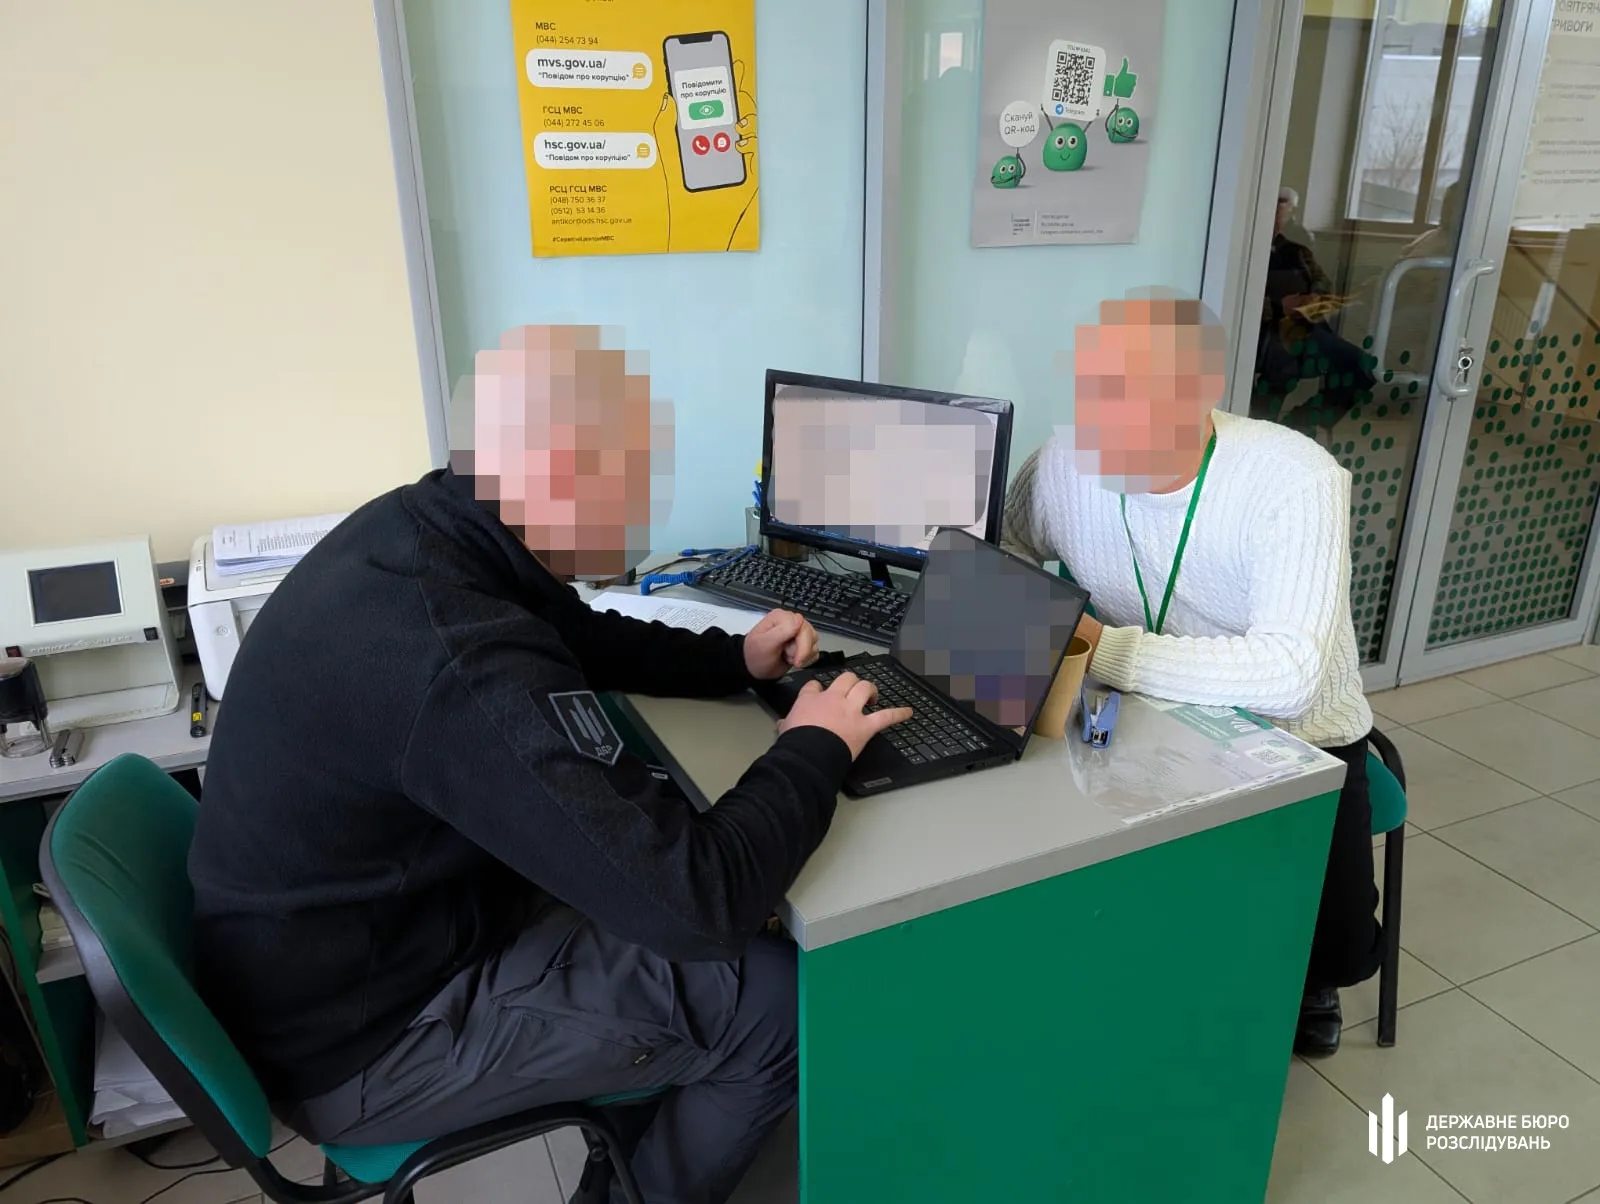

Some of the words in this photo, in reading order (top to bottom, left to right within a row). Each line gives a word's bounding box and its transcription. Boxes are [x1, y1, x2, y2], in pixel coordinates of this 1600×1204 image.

[535, 22, 556, 31] МВС
[536, 35, 557, 45] (044)
[559, 36, 575, 44] 254
[588, 37, 599, 45] 94
[537, 58, 607, 70] mvs.gov.ua/
[681, 80, 723, 89] Повідомити
[680, 91, 694, 99] про
[695, 88, 727, 97] корупцію
[542, 106, 561, 115] ГСЦ
[563, 106, 583, 114] МВС
[1004, 112, 1033, 122] Скануй
[543, 119, 564, 128] (044)
[565, 119, 580, 127] 272
[582, 119, 592, 127] 45
[594, 119, 605, 127] 06
[1004, 125, 1035, 135] QR-код
[544, 139, 606, 151] hsc.gov.ua/
[549, 185, 568, 194] РСЦ
[569, 185, 587, 193] ГСЦ
[588, 185, 608, 193] МВС
[570, 196, 585, 204] 750
[550, 207, 573, 216] (0512)
